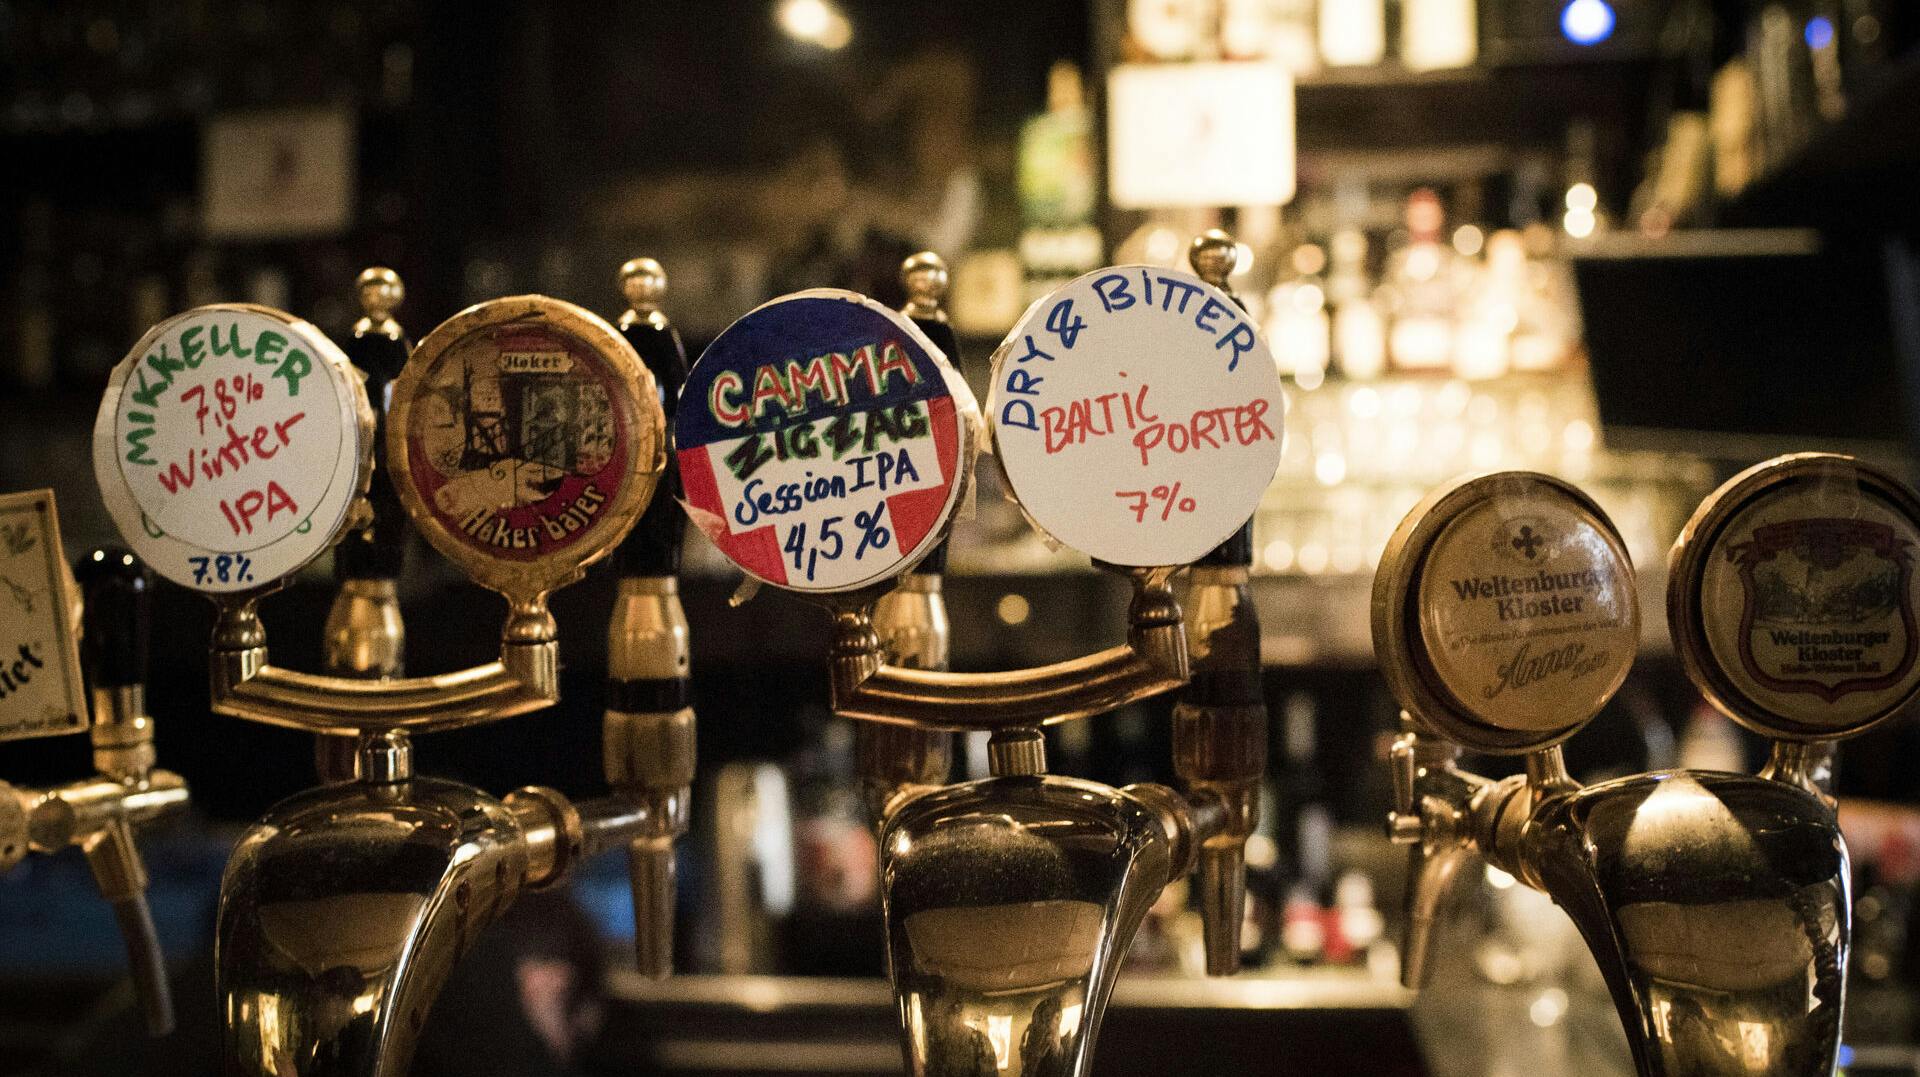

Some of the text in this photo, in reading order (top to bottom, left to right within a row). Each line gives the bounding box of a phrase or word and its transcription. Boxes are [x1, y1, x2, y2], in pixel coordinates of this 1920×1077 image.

[708, 340, 925, 428] GAMMA
[1001, 270, 1255, 431] DRY & BITTER
[126, 323, 312, 466] MIKKELLER
[181, 373, 264, 435] 7,8%
[158, 412, 305, 494] Winter
[1132, 398, 1275, 466] PORTER
[220, 480, 299, 537] IPA
[735, 447, 920, 526] Session IPA
[1115, 481, 1197, 523] 7%
[189, 552, 254, 586] 7.8%
[1497, 594, 1585, 622] Kloster
